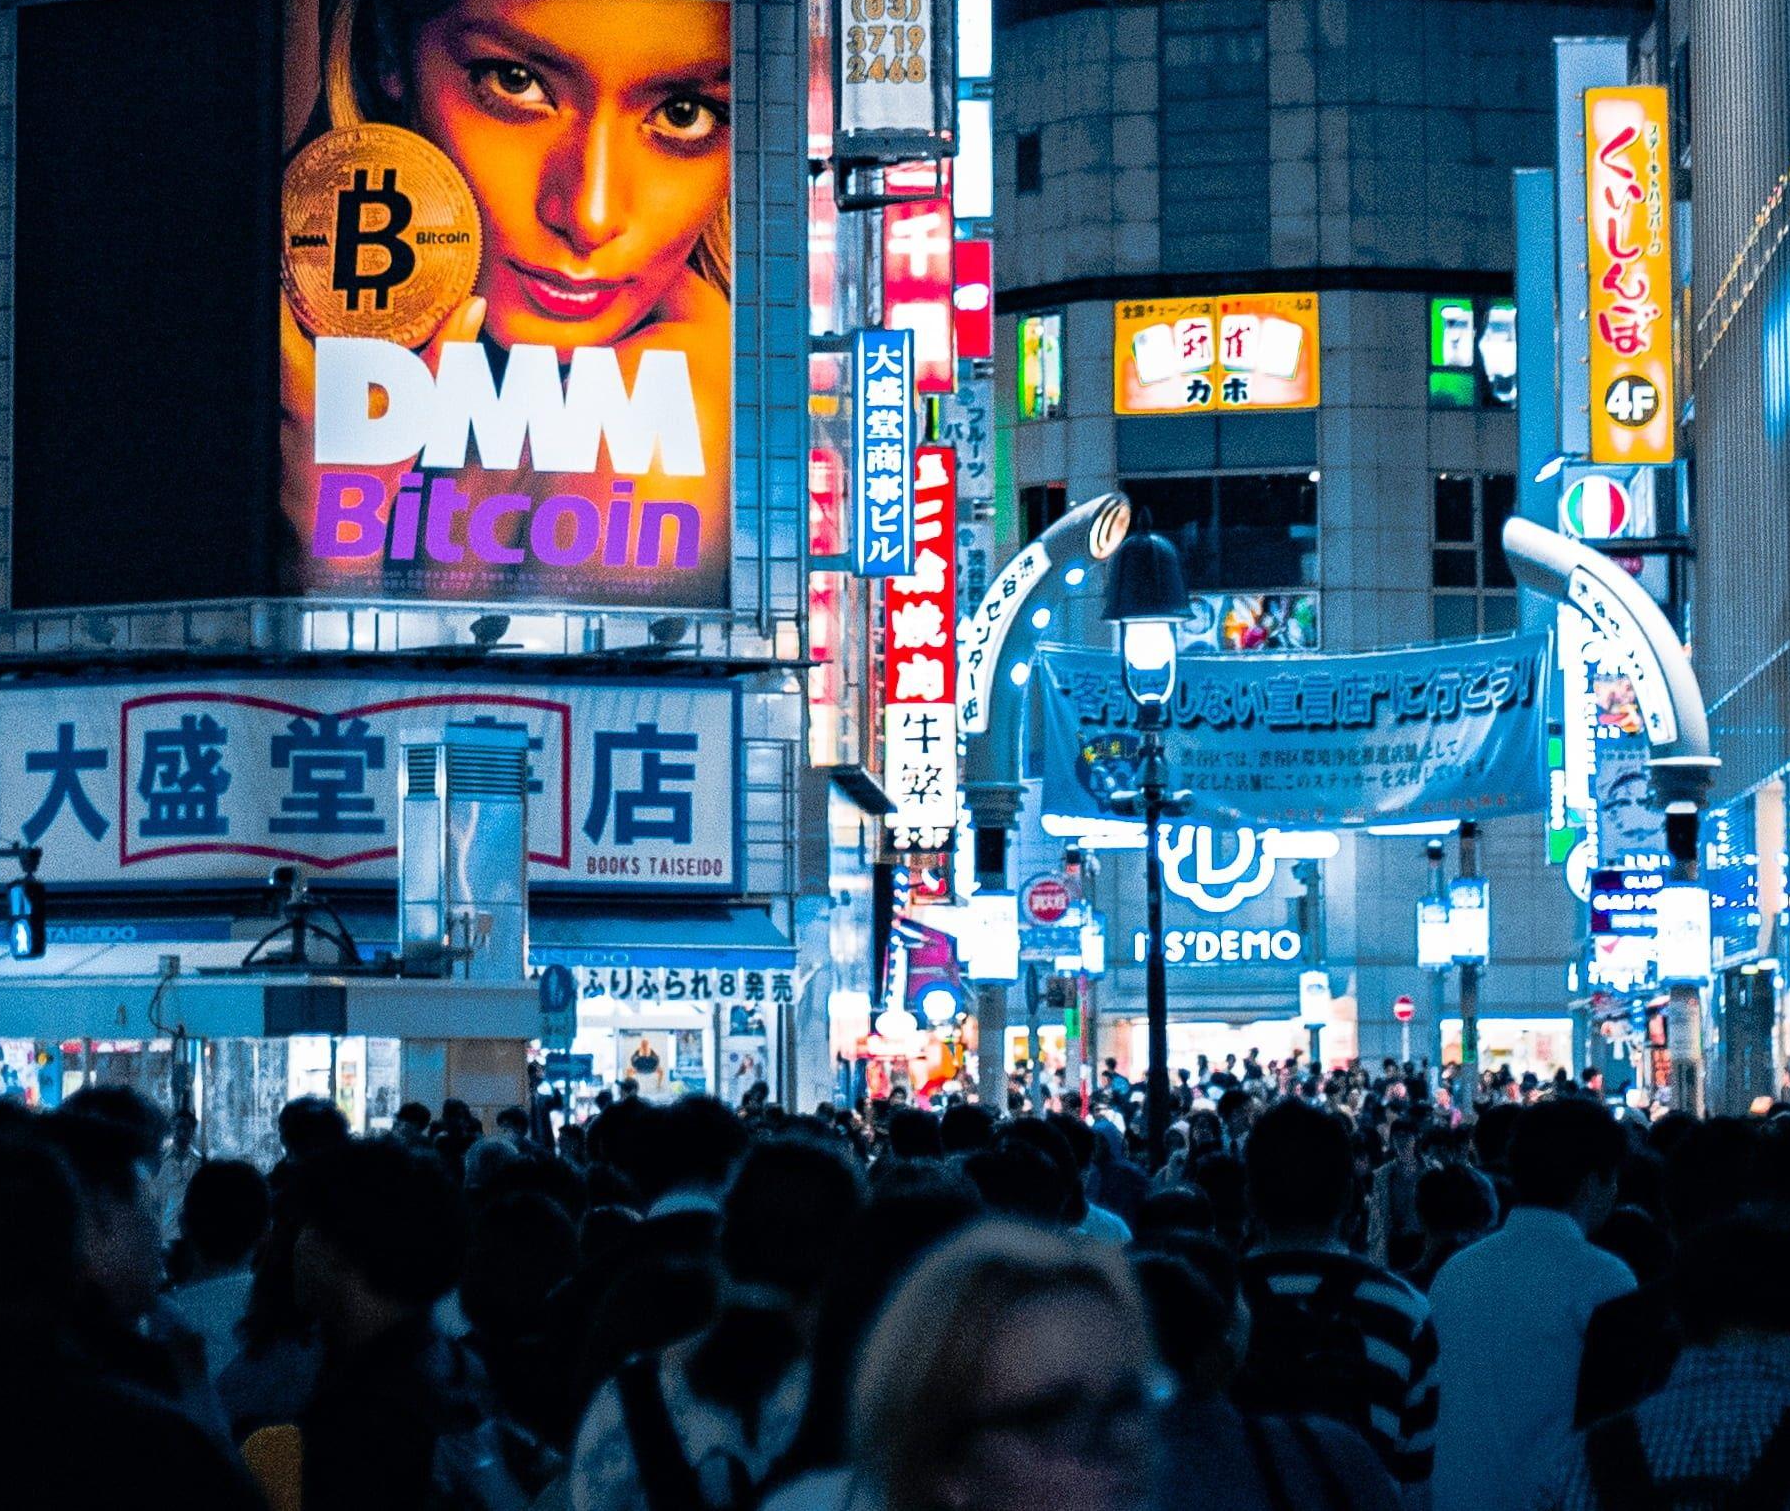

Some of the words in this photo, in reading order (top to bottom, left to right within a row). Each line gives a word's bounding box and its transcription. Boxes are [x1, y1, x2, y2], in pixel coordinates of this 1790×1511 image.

[846, 24, 926, 55] 3719
[846, 54, 927, 86] 2468
[416, 230, 471, 247] Bitcoin
[1600, 127, 1661, 355] くいしんぼ
[315, 338, 705, 475] DMM
[1606, 381, 1655, 422] 4F
[866, 344, 903, 564] 大盛堂商事ビル
[309, 473, 703, 569] Bitcoin
[23, 714, 698, 846] 大盛堂店
[586, 855, 640, 876] BOOKS
[649, 855, 723, 878] TAISEIDO
[1135, 929, 1301, 963] IS'DEMO
